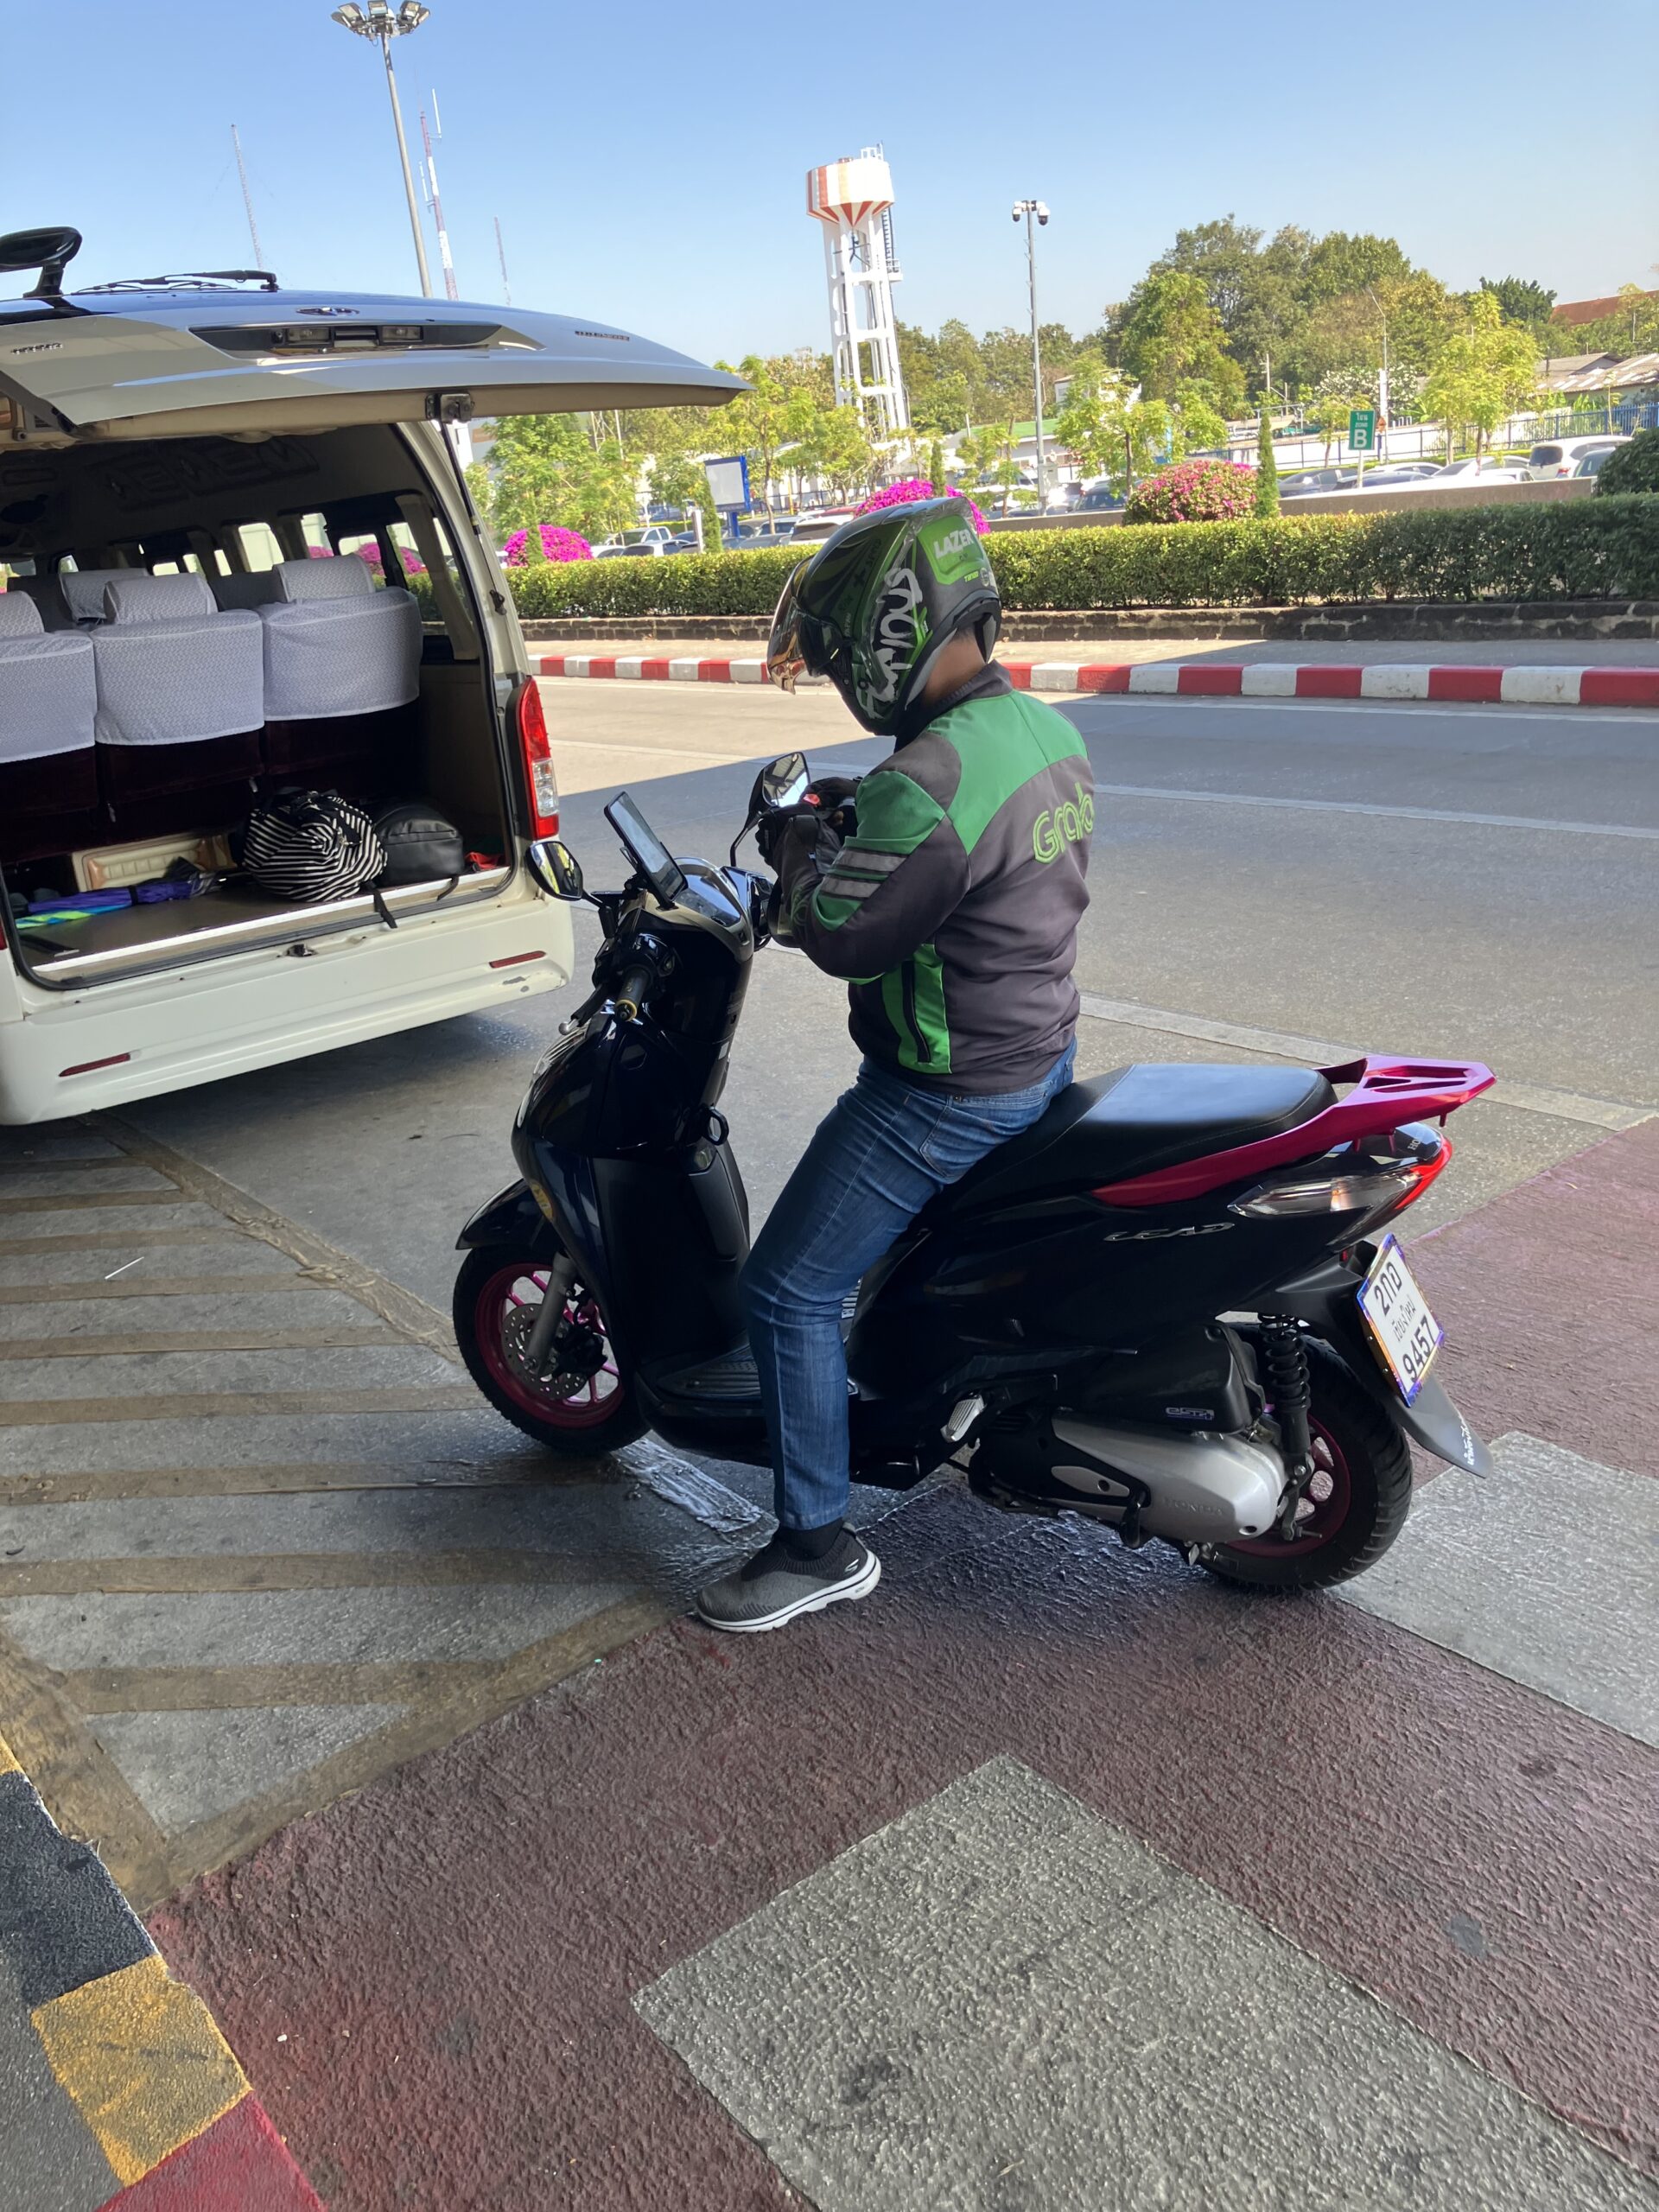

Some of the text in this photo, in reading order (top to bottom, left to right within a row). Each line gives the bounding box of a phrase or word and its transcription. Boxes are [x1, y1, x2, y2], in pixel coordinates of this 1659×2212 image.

[1353, 429, 1367, 448] B
[933, 529, 974, 559] LAZER
[1033, 781, 1095, 863] Grab
[1402, 1314, 1436, 1383] 9457
